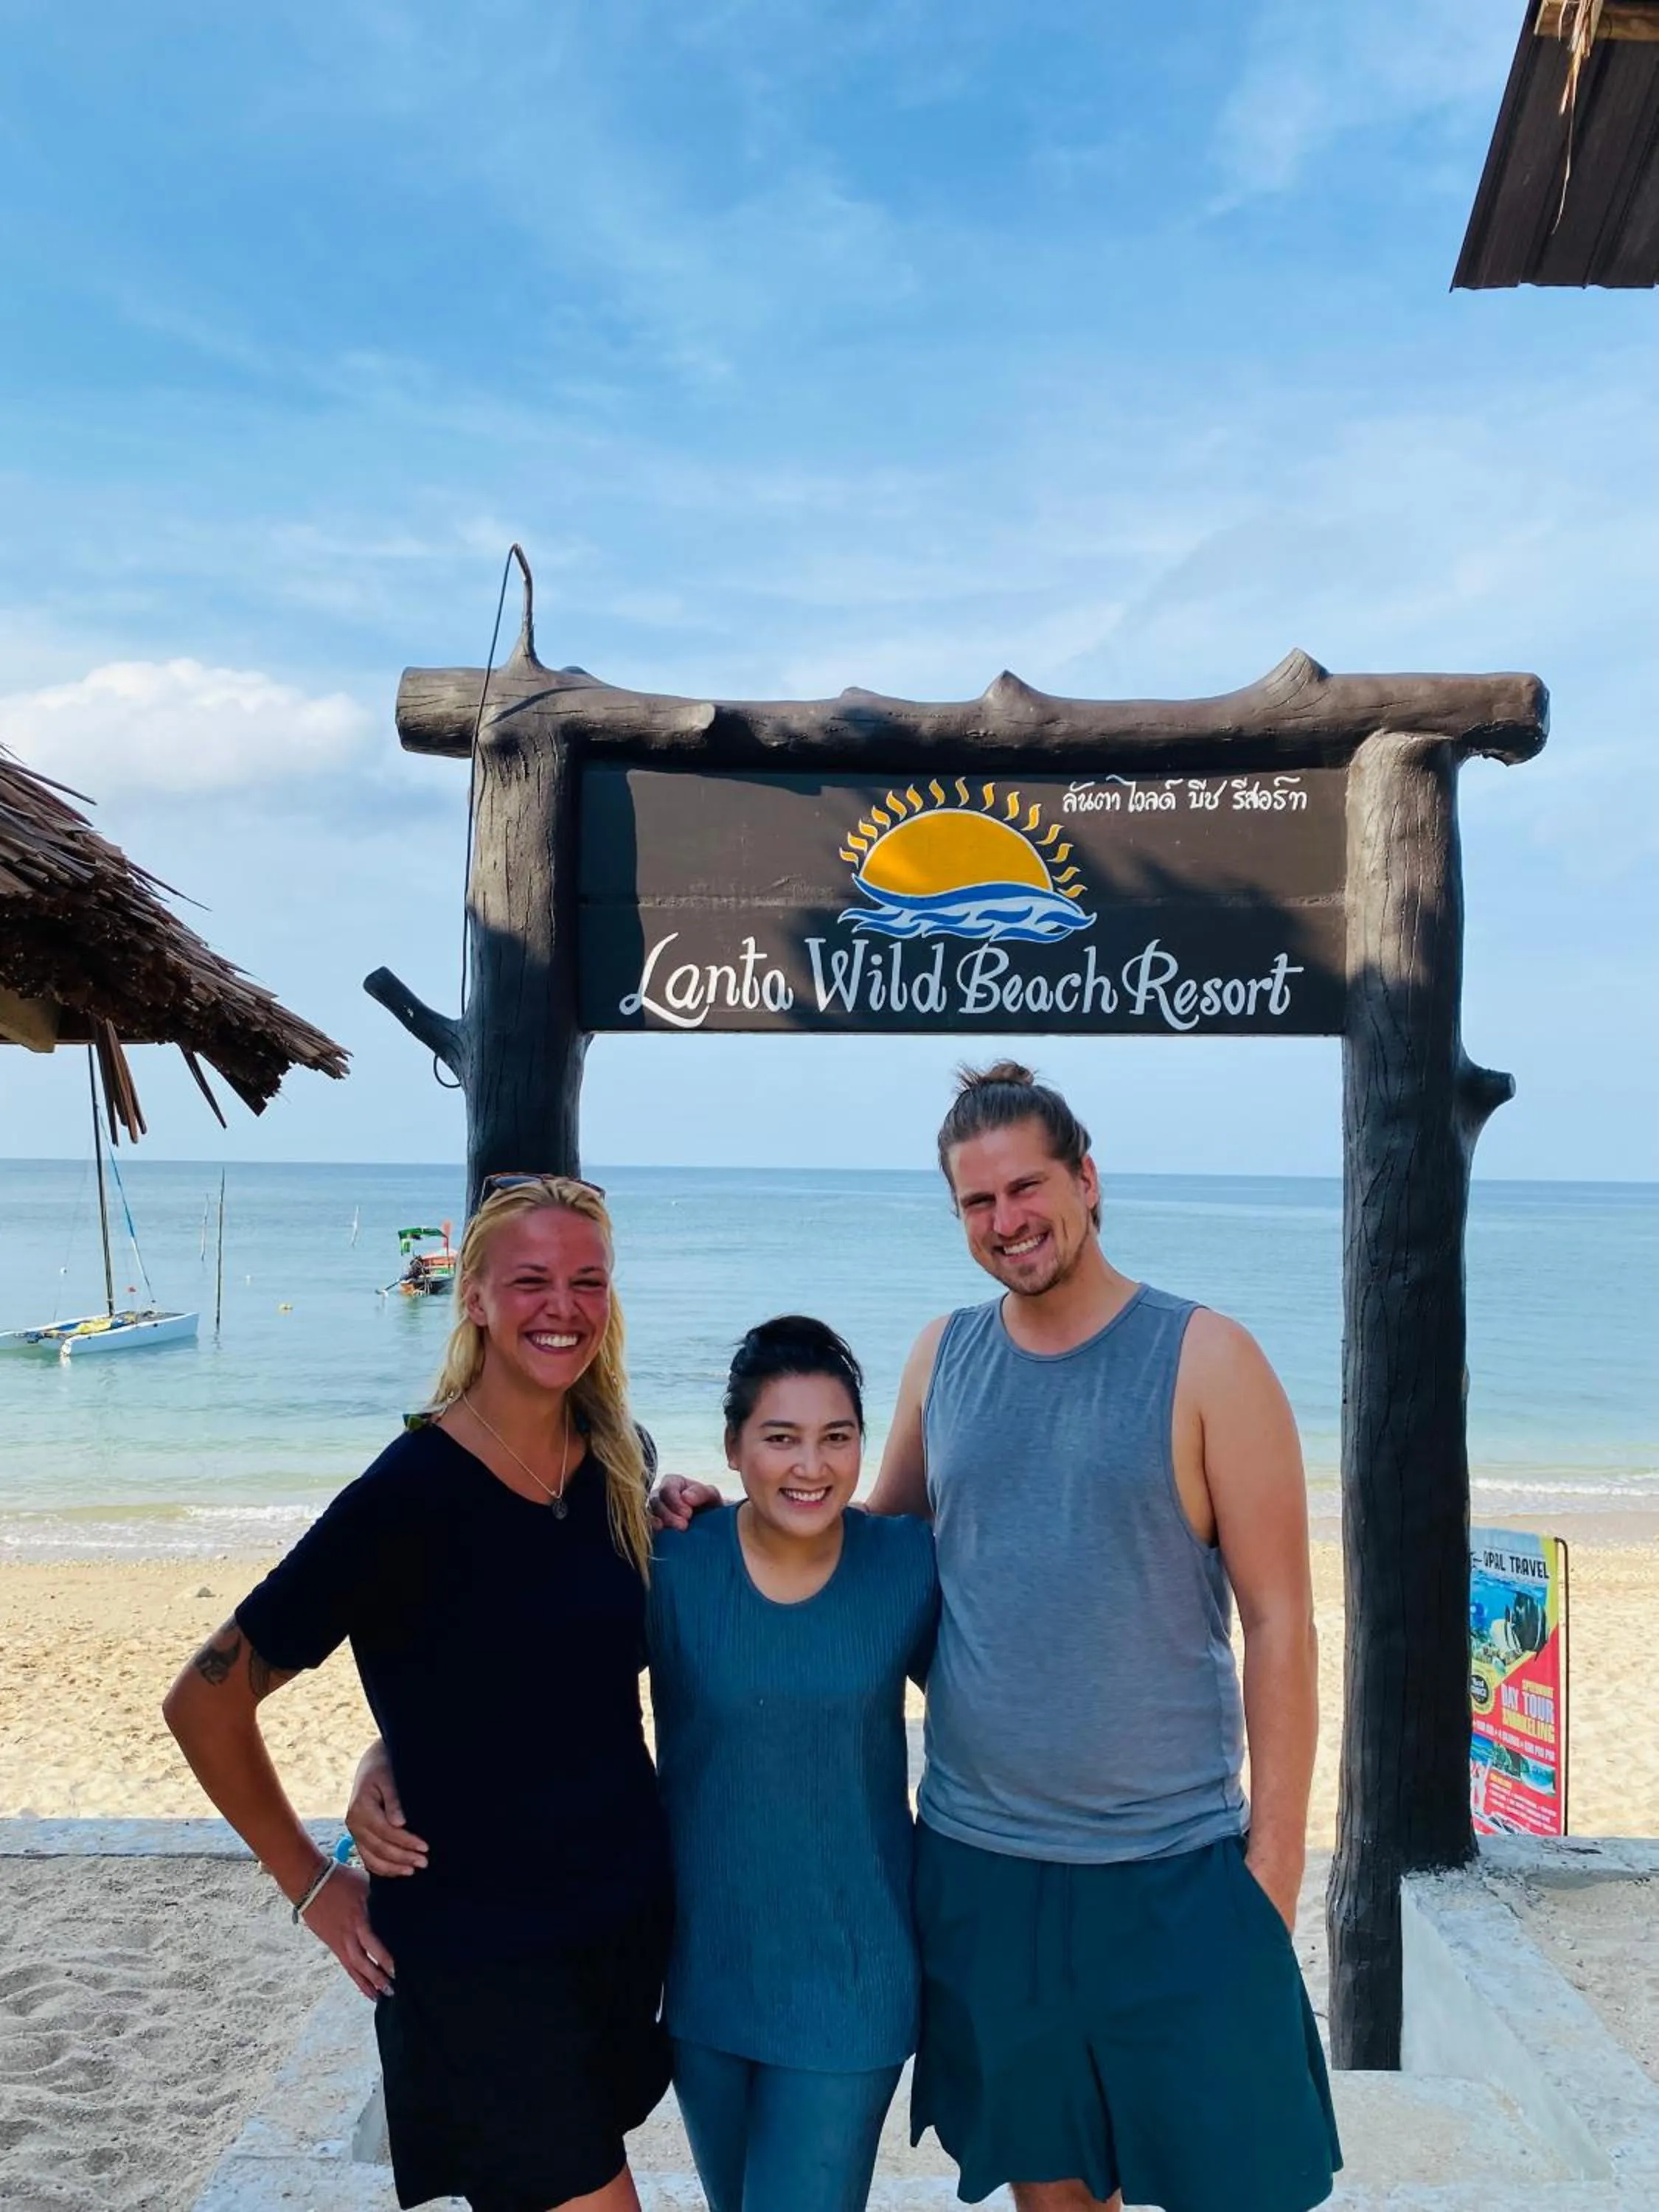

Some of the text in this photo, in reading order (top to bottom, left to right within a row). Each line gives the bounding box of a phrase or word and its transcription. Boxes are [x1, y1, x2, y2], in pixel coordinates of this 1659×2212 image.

[1188, 779, 1228, 811] บีช
[619, 931, 1305, 1030] Lanta Wild Beach Resort
[1509, 1555, 1550, 1579] TRAVEL
[1521, 1691, 1554, 1725] TOUR
